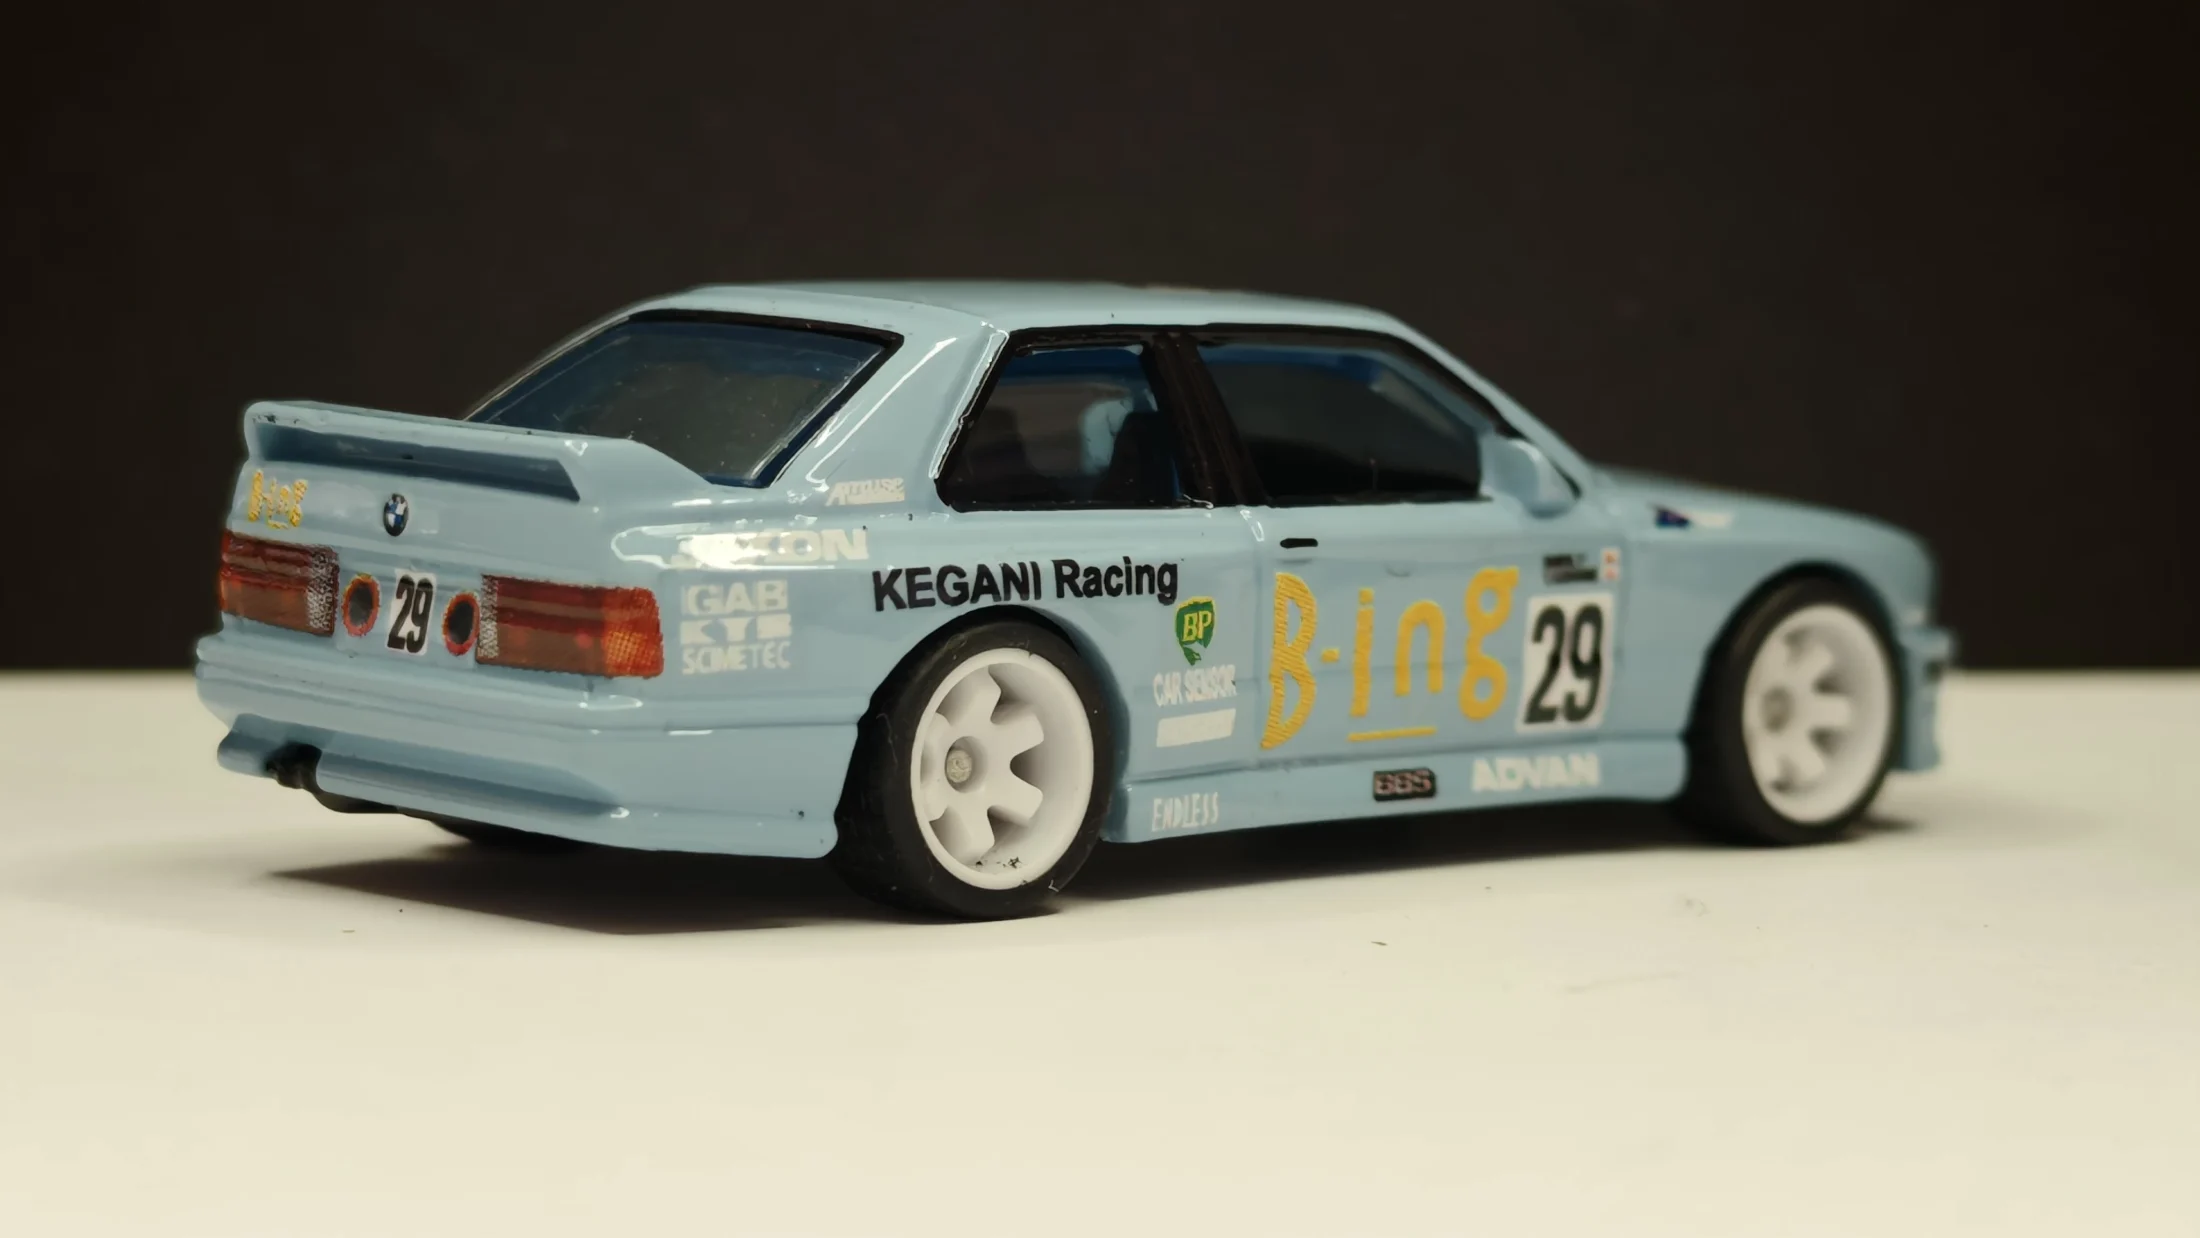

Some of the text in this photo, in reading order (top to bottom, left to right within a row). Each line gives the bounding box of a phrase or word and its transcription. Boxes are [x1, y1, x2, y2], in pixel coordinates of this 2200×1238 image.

[683, 580, 788, 616] GAB
[872, 555, 1178, 612] KEGANI Racing
[387, 575, 434, 653] 29
[1181, 610, 1213, 642] BP
[1523, 602, 1604, 726] 29
[1153, 664, 1238, 707] CAR SENSOR
[1472, 753, 1600, 793] ADVAN
[1151, 791, 1219, 833] ENDLESS
